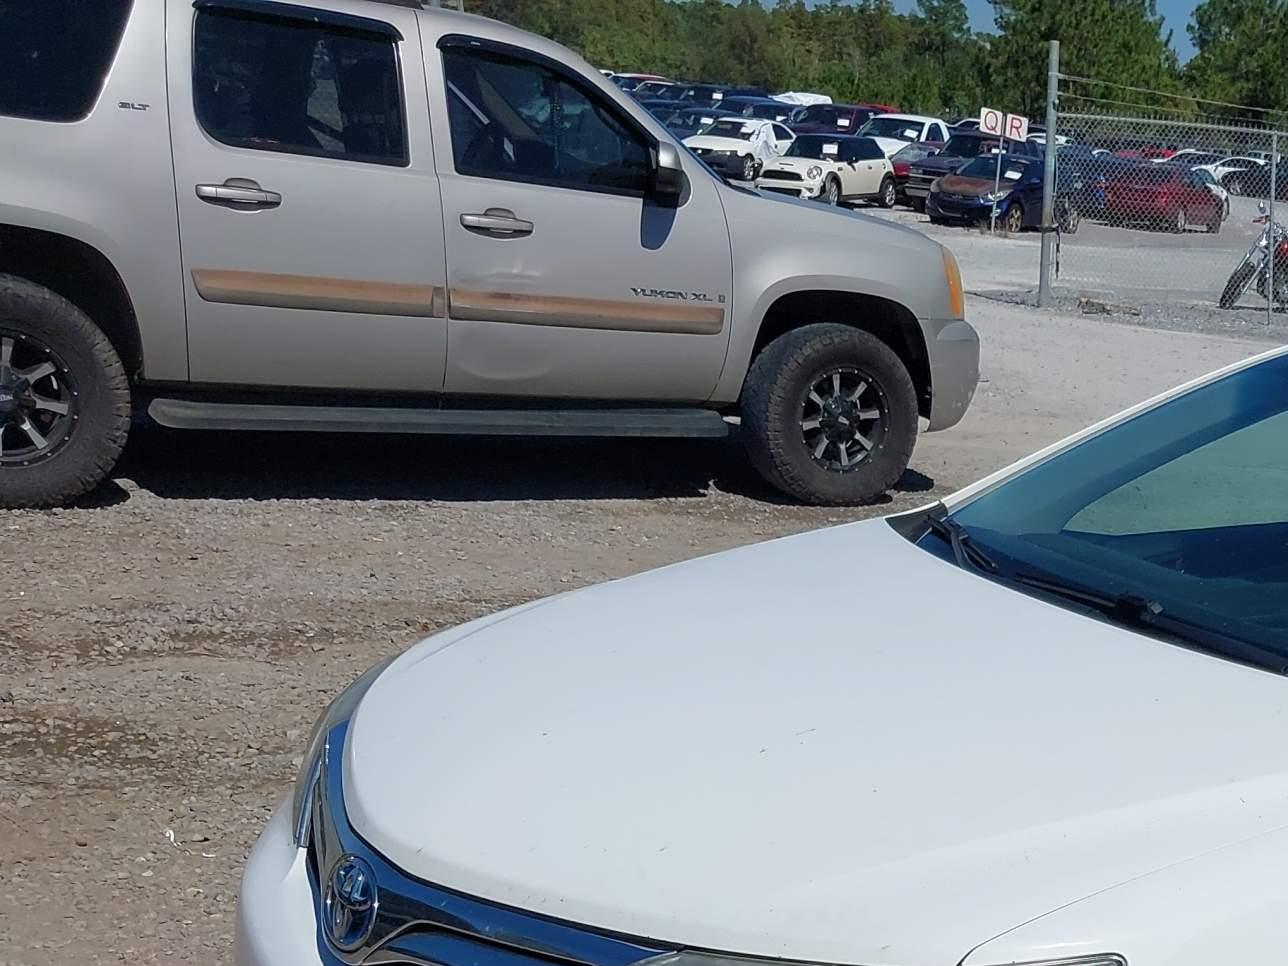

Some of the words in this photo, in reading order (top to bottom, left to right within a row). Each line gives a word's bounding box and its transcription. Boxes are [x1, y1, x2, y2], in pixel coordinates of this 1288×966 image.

[984, 110, 998, 133] Q
[1010, 116, 1022, 139] R
[630, 287, 688, 301] YUKON
[690, 292, 713, 302] XL
